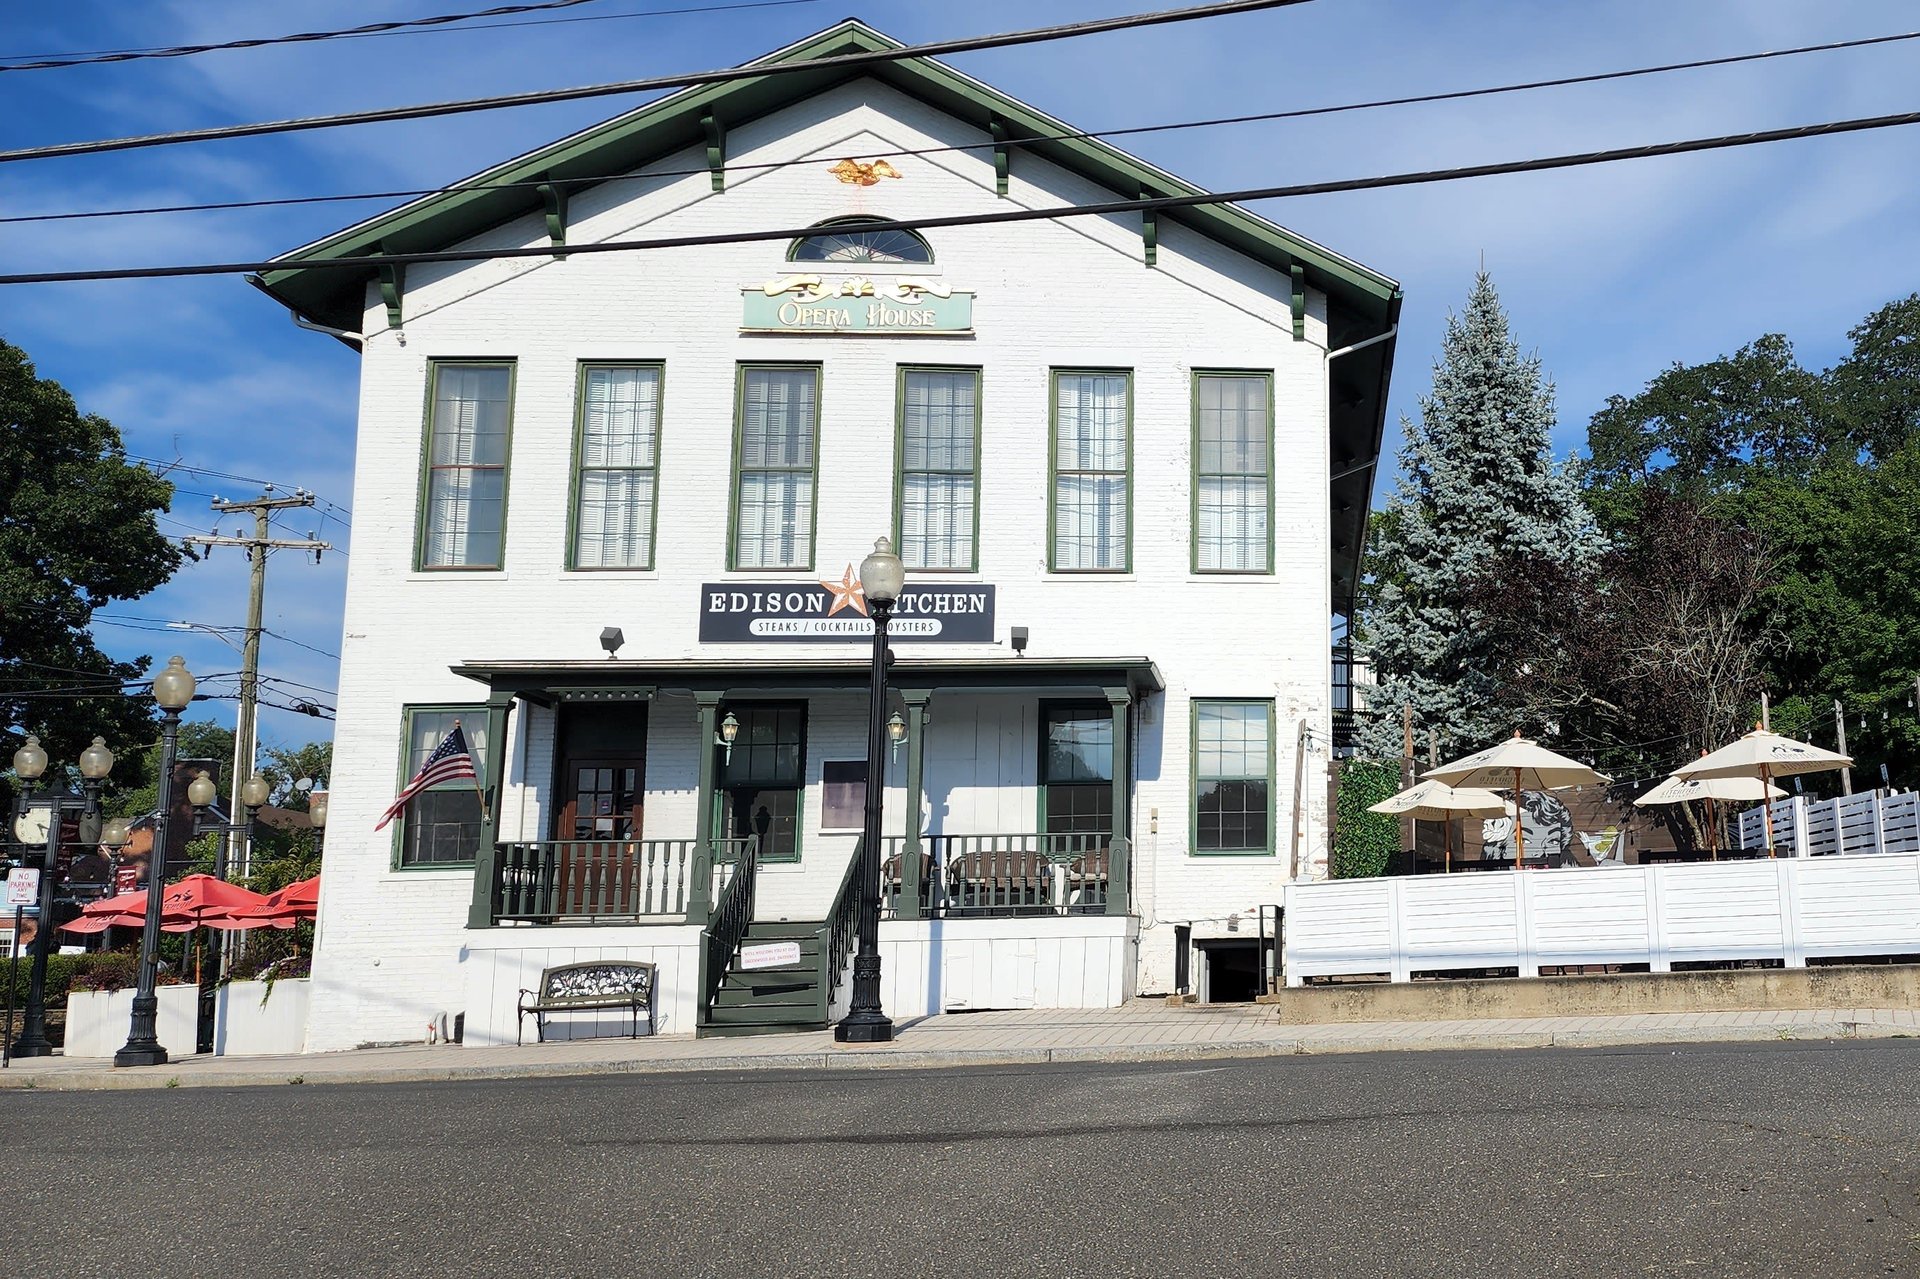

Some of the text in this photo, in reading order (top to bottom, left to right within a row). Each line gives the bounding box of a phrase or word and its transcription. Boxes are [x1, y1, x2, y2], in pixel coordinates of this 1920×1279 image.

[708, 592, 986, 614] EDISON ITCHEN
[758, 622, 798, 632] STEAKS
[814, 622, 872, 632] COCKTAILS
[887, 622, 934, 632] OYSTERS
